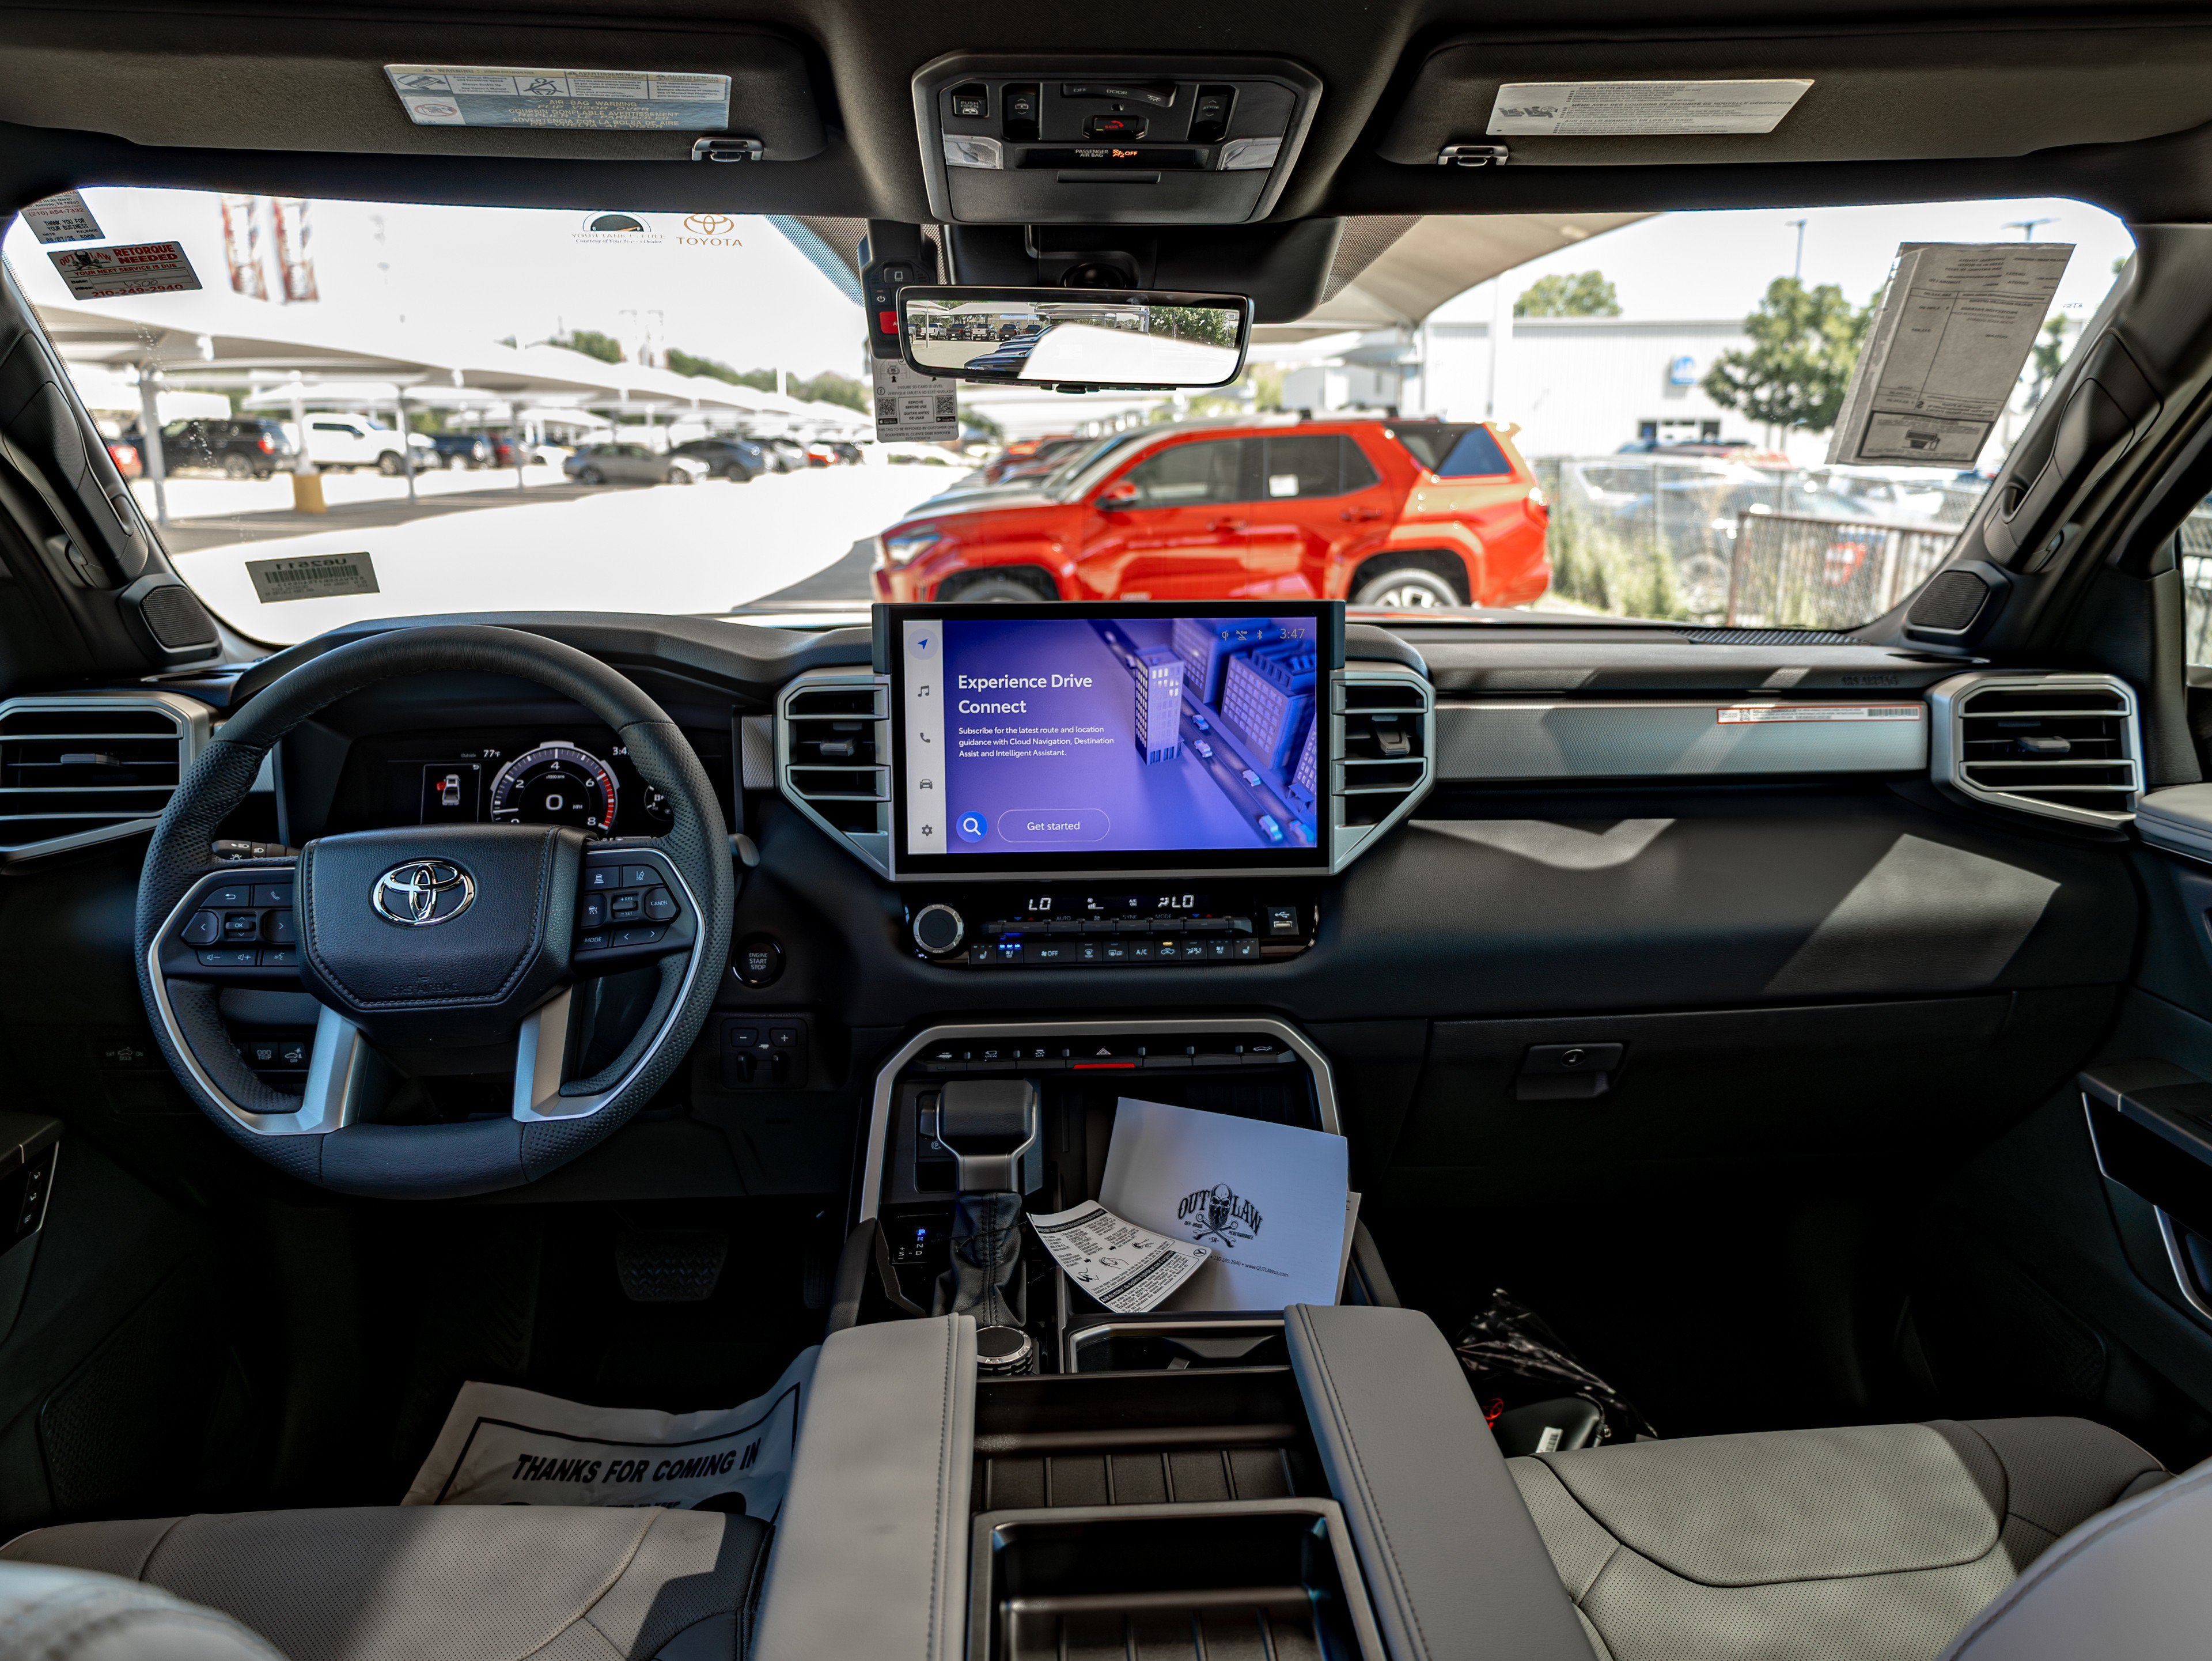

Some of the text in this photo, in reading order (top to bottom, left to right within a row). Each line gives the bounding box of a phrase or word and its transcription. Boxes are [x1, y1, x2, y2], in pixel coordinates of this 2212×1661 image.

[676, 237, 743, 247] TOYOTA
[113, 244, 175, 257] RETORQUE
[116, 253, 178, 264] NEEDED
[91, 284, 184, 298] 210-249-2940
[1279, 627, 1306, 640] 3:47
[958, 674, 1092, 693] Experience Drive
[958, 699, 1027, 714] Connect
[1075, 725, 1104, 733] location
[959, 738, 992, 747] guidance
[1009, 737, 1031, 746] Cloud
[1032, 737, 1073, 746] Navigation,
[1074, 737, 1114, 745] Destination
[612, 746, 630, 756] 3:4
[995, 749, 1032, 758] Intelligent
[550, 761, 560, 770] 4
[515, 779, 525, 789] 2
[585, 778, 596, 788] 6
[546, 793, 564, 811] 0
[587, 816, 597, 826] 8
[1027, 820, 1081, 831] Get started
[1028, 897, 1052, 911] LO
[1171, 895, 1195, 909] LO
[392, 982, 459, 993] SRS AIRBAG
[1184, 1220, 1203, 1228] OFF-ROAD
[1228, 1230, 1254, 1240] PERFORMANCE
[1213, 1255, 1289, 1278] 210.249.2940 www.OUTLAWsa.com
[512, 1437, 762, 1484] THANKS FOR COMING IN
